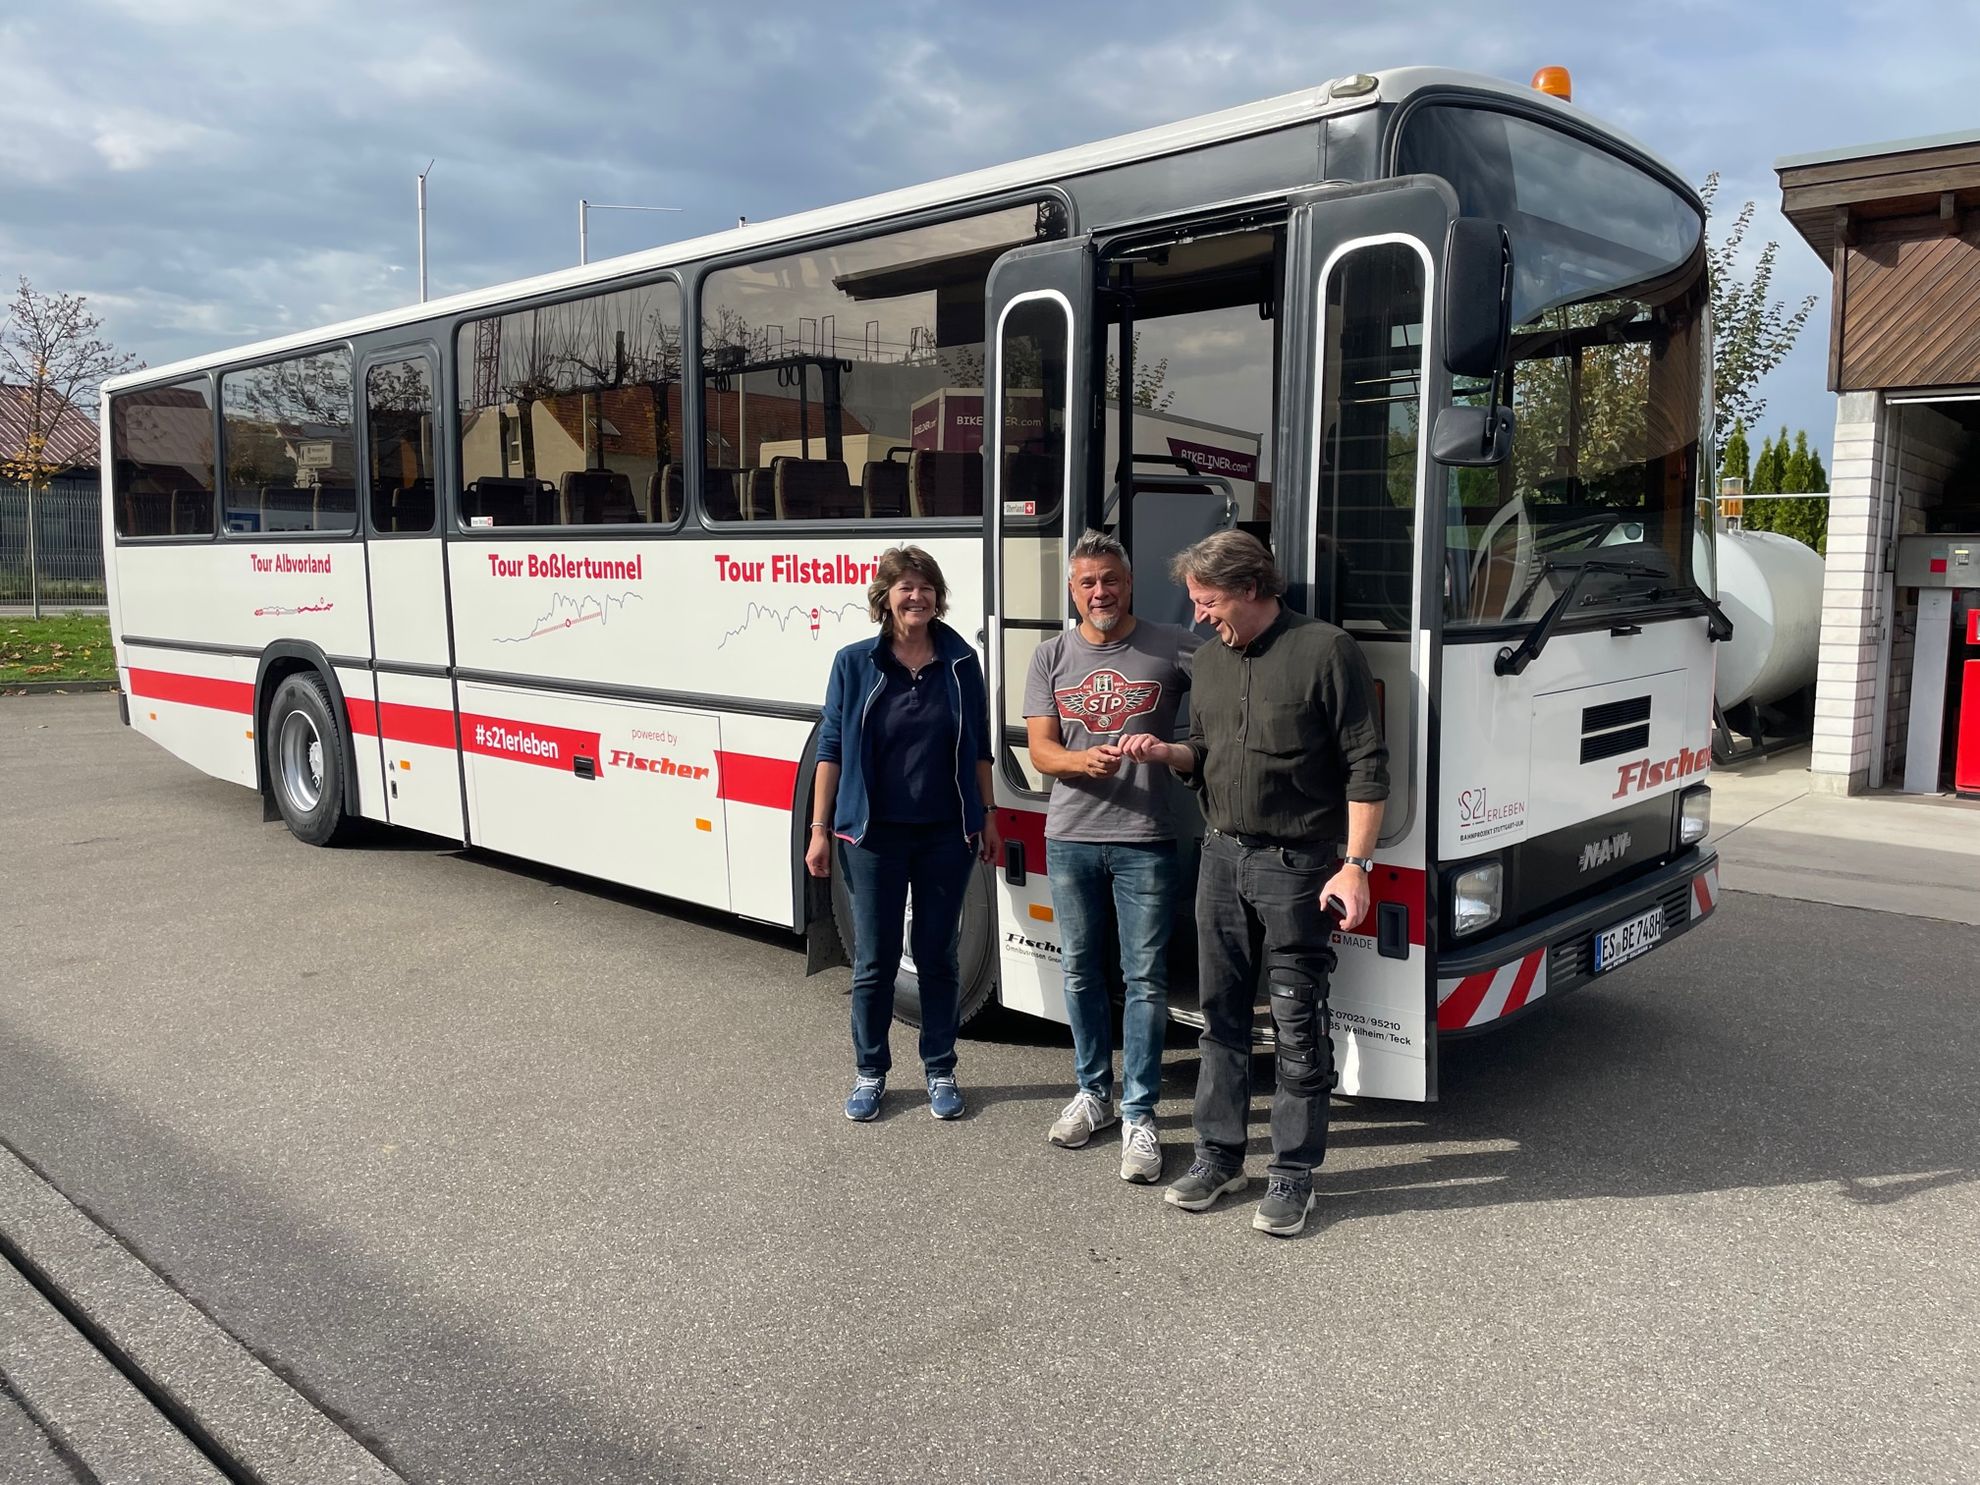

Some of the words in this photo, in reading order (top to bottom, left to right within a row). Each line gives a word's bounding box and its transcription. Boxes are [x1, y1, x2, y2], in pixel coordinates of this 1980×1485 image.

[250, 553, 273, 572] Tour
[275, 553, 332, 574] Albvorland
[488, 553, 524, 578] Tour
[528, 553, 642, 580] Boßlertunnel
[714, 554, 765, 583] Tour
[1088, 693, 1122, 713] STP
[475, 724, 560, 759] #s21erleben
[631, 728, 665, 743] powered
[667, 733, 678, 745] by
[607, 749, 710, 781] Fischer
[1487, 801, 1525, 822] ERLEBEN
[1459, 828, 1493, 842] BAHNPROJEKT
[1343, 935, 1373, 950] MADE
[1602, 932, 1616, 962] ES
[1622, 923, 1636, 953] BE
[1637, 910, 1662, 945] 748H
[1335, 1010, 1401, 1031] 07023/95210
[1343, 1023, 1411, 1046] Weilheim/Teck
